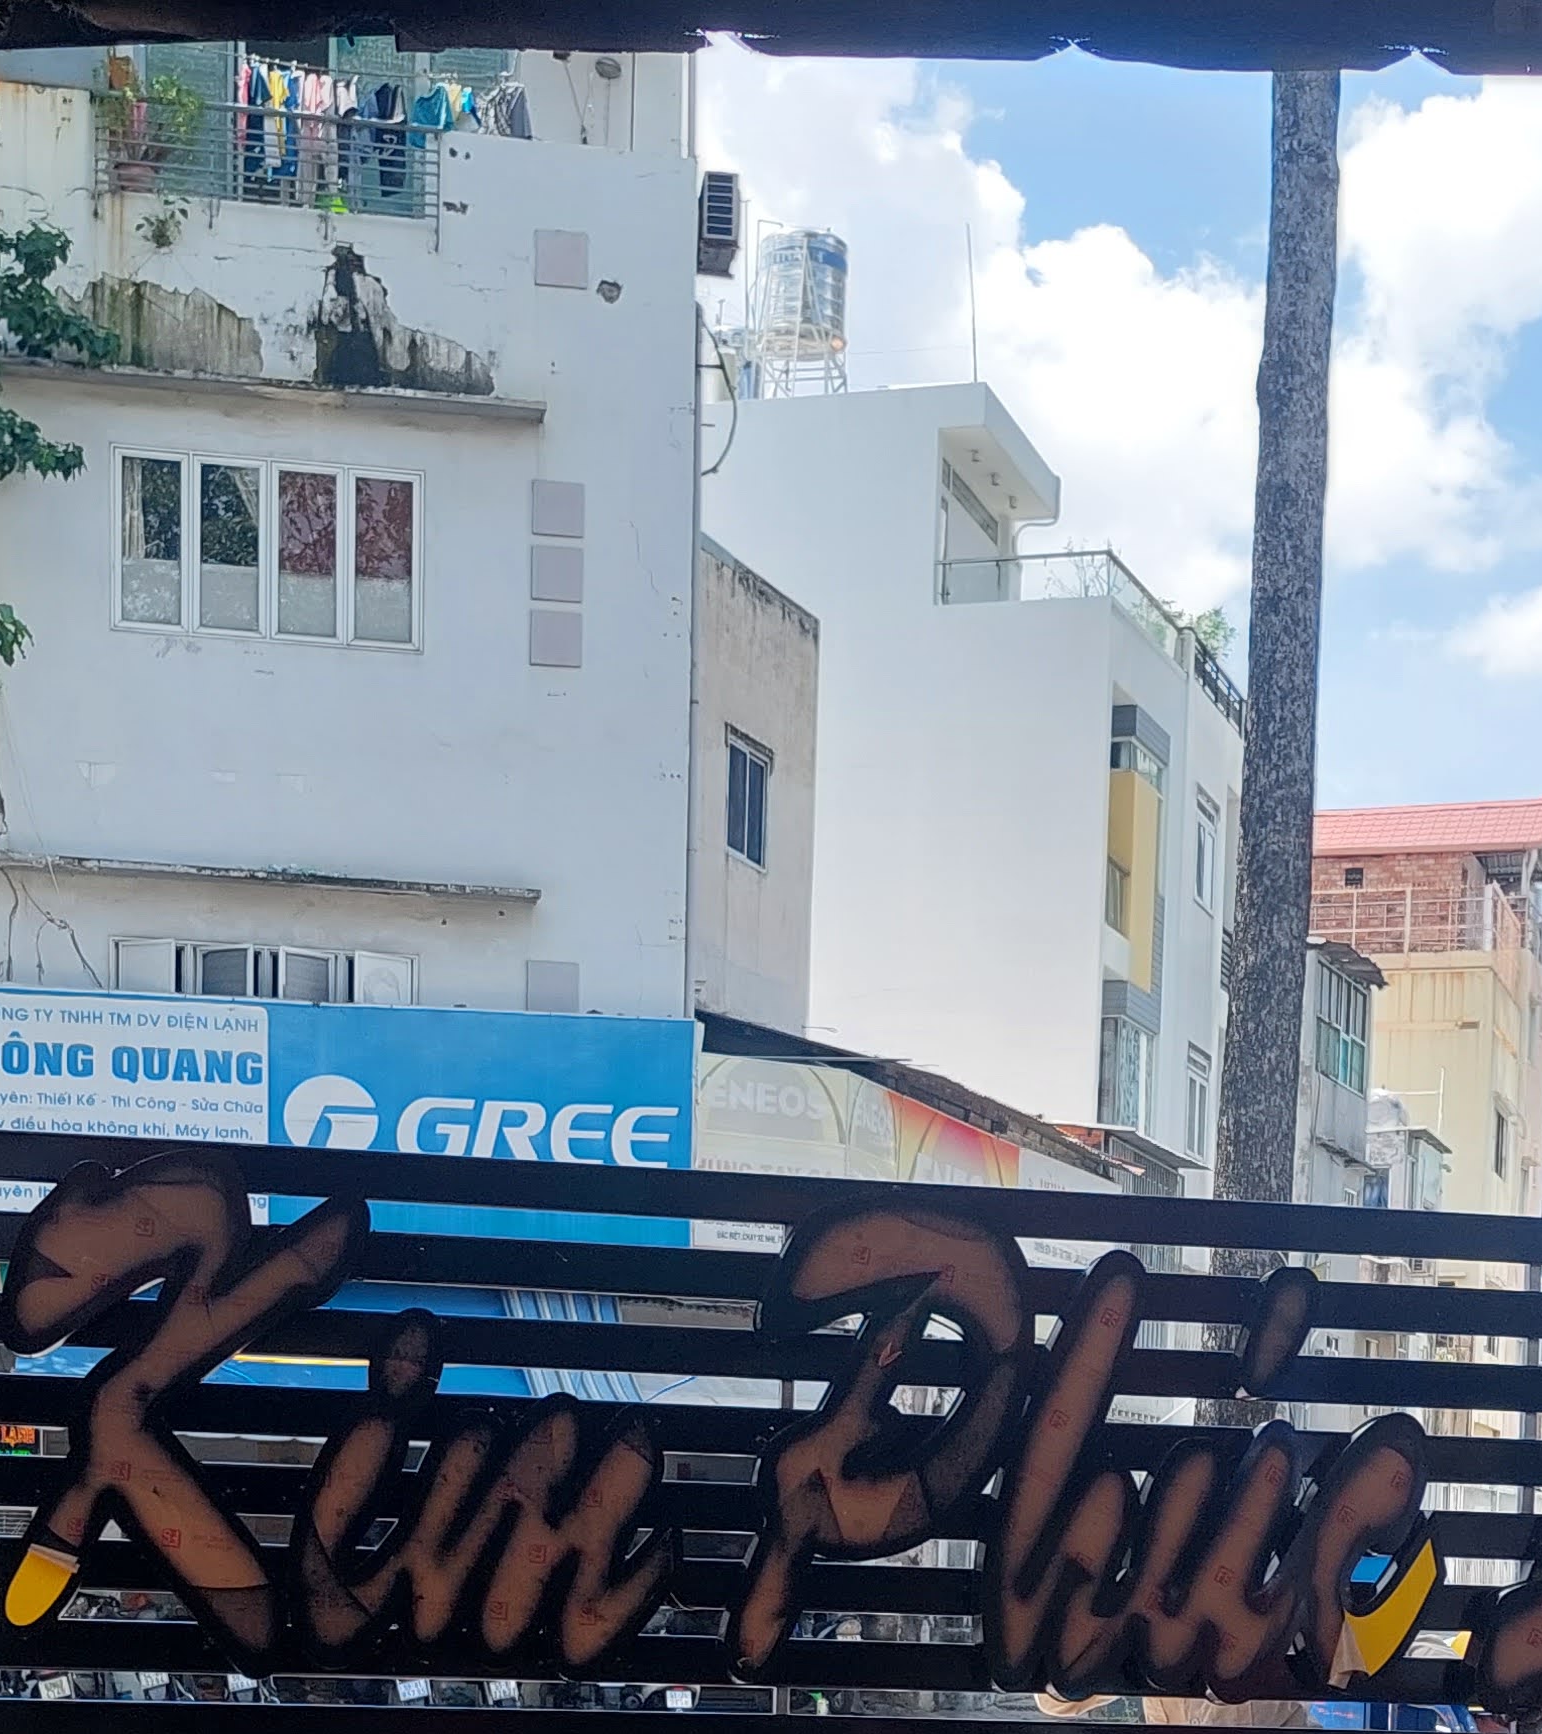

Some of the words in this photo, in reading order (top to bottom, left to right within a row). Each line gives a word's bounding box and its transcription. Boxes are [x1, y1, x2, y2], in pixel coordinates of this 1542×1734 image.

[34, 1008, 53, 1023] TY
[60, 1010, 103, 1024] TNHH
[109, 1012, 131, 1026] TM
[137, 1014, 161, 1027] DV
[167, 1013, 208, 1031] ĐIỆN
[214, 1017, 259, 1033] LẠNH
[111, 1046, 263, 1085] QUANG
[37, 1091, 72, 1106] Thiết
[111, 1095, 130, 1108] Thi
[135, 1096, 177, 1113] Công
[191, 1096, 219, 1112] Sửa
[223, 1099, 264, 1114] Chữa
[711, 1079, 827, 1119] ENEOS
[87, 1120, 138, 1137] không
[175, 1123, 210, 1140] Máy
[396, 1098, 679, 1168] GREE
[1, 1155, 675, 1682] Kim
[727, 1198, 1443, 1705] Phúc
